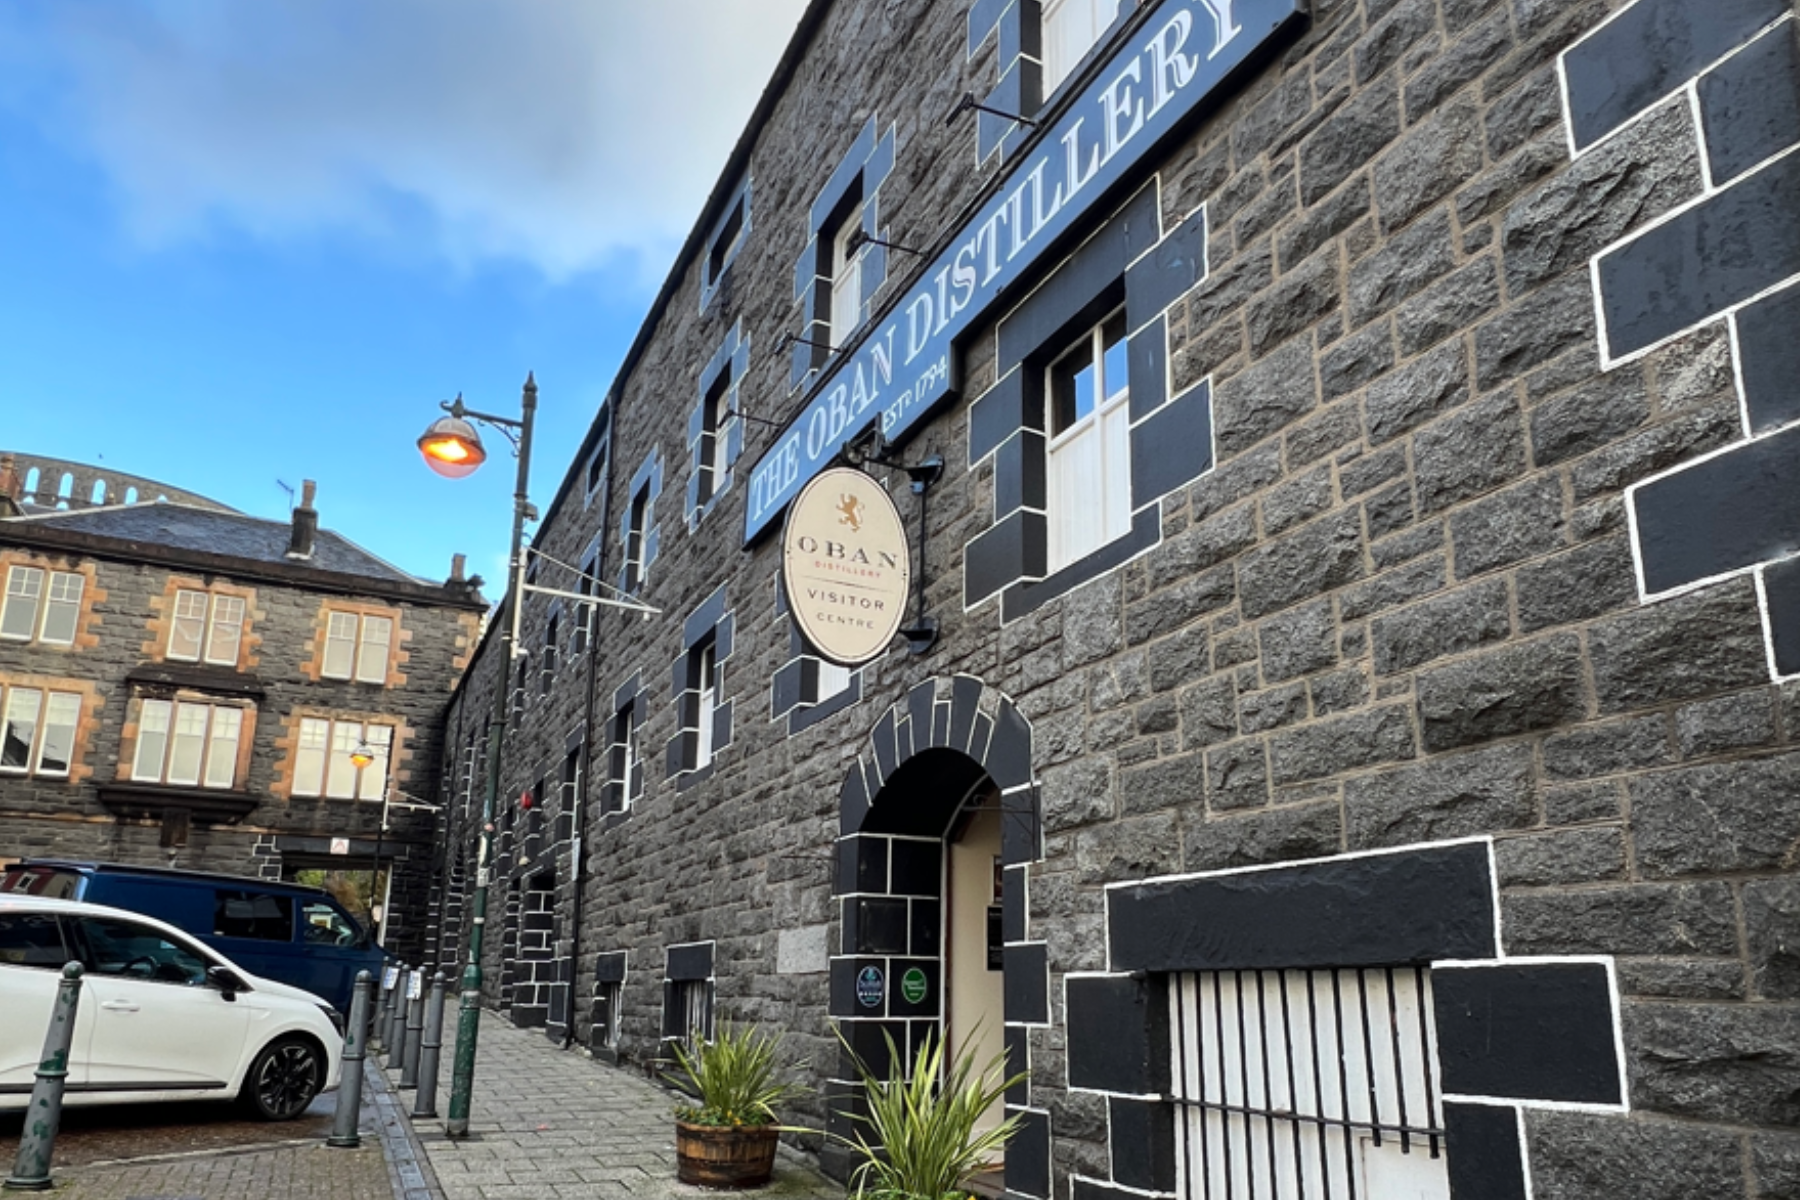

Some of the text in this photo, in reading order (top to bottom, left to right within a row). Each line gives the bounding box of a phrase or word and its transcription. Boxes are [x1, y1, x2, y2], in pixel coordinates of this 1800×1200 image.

[752, 0, 1242, 521] THE OBAN DISTILLERY
[916, 354, 947, 403] 1794
[797, 536, 898, 570] OBAN
[814, 560, 881, 578] DISTILLERY
[807, 588, 885, 611] VISITOR
[816, 612, 874, 630] CENTRE
